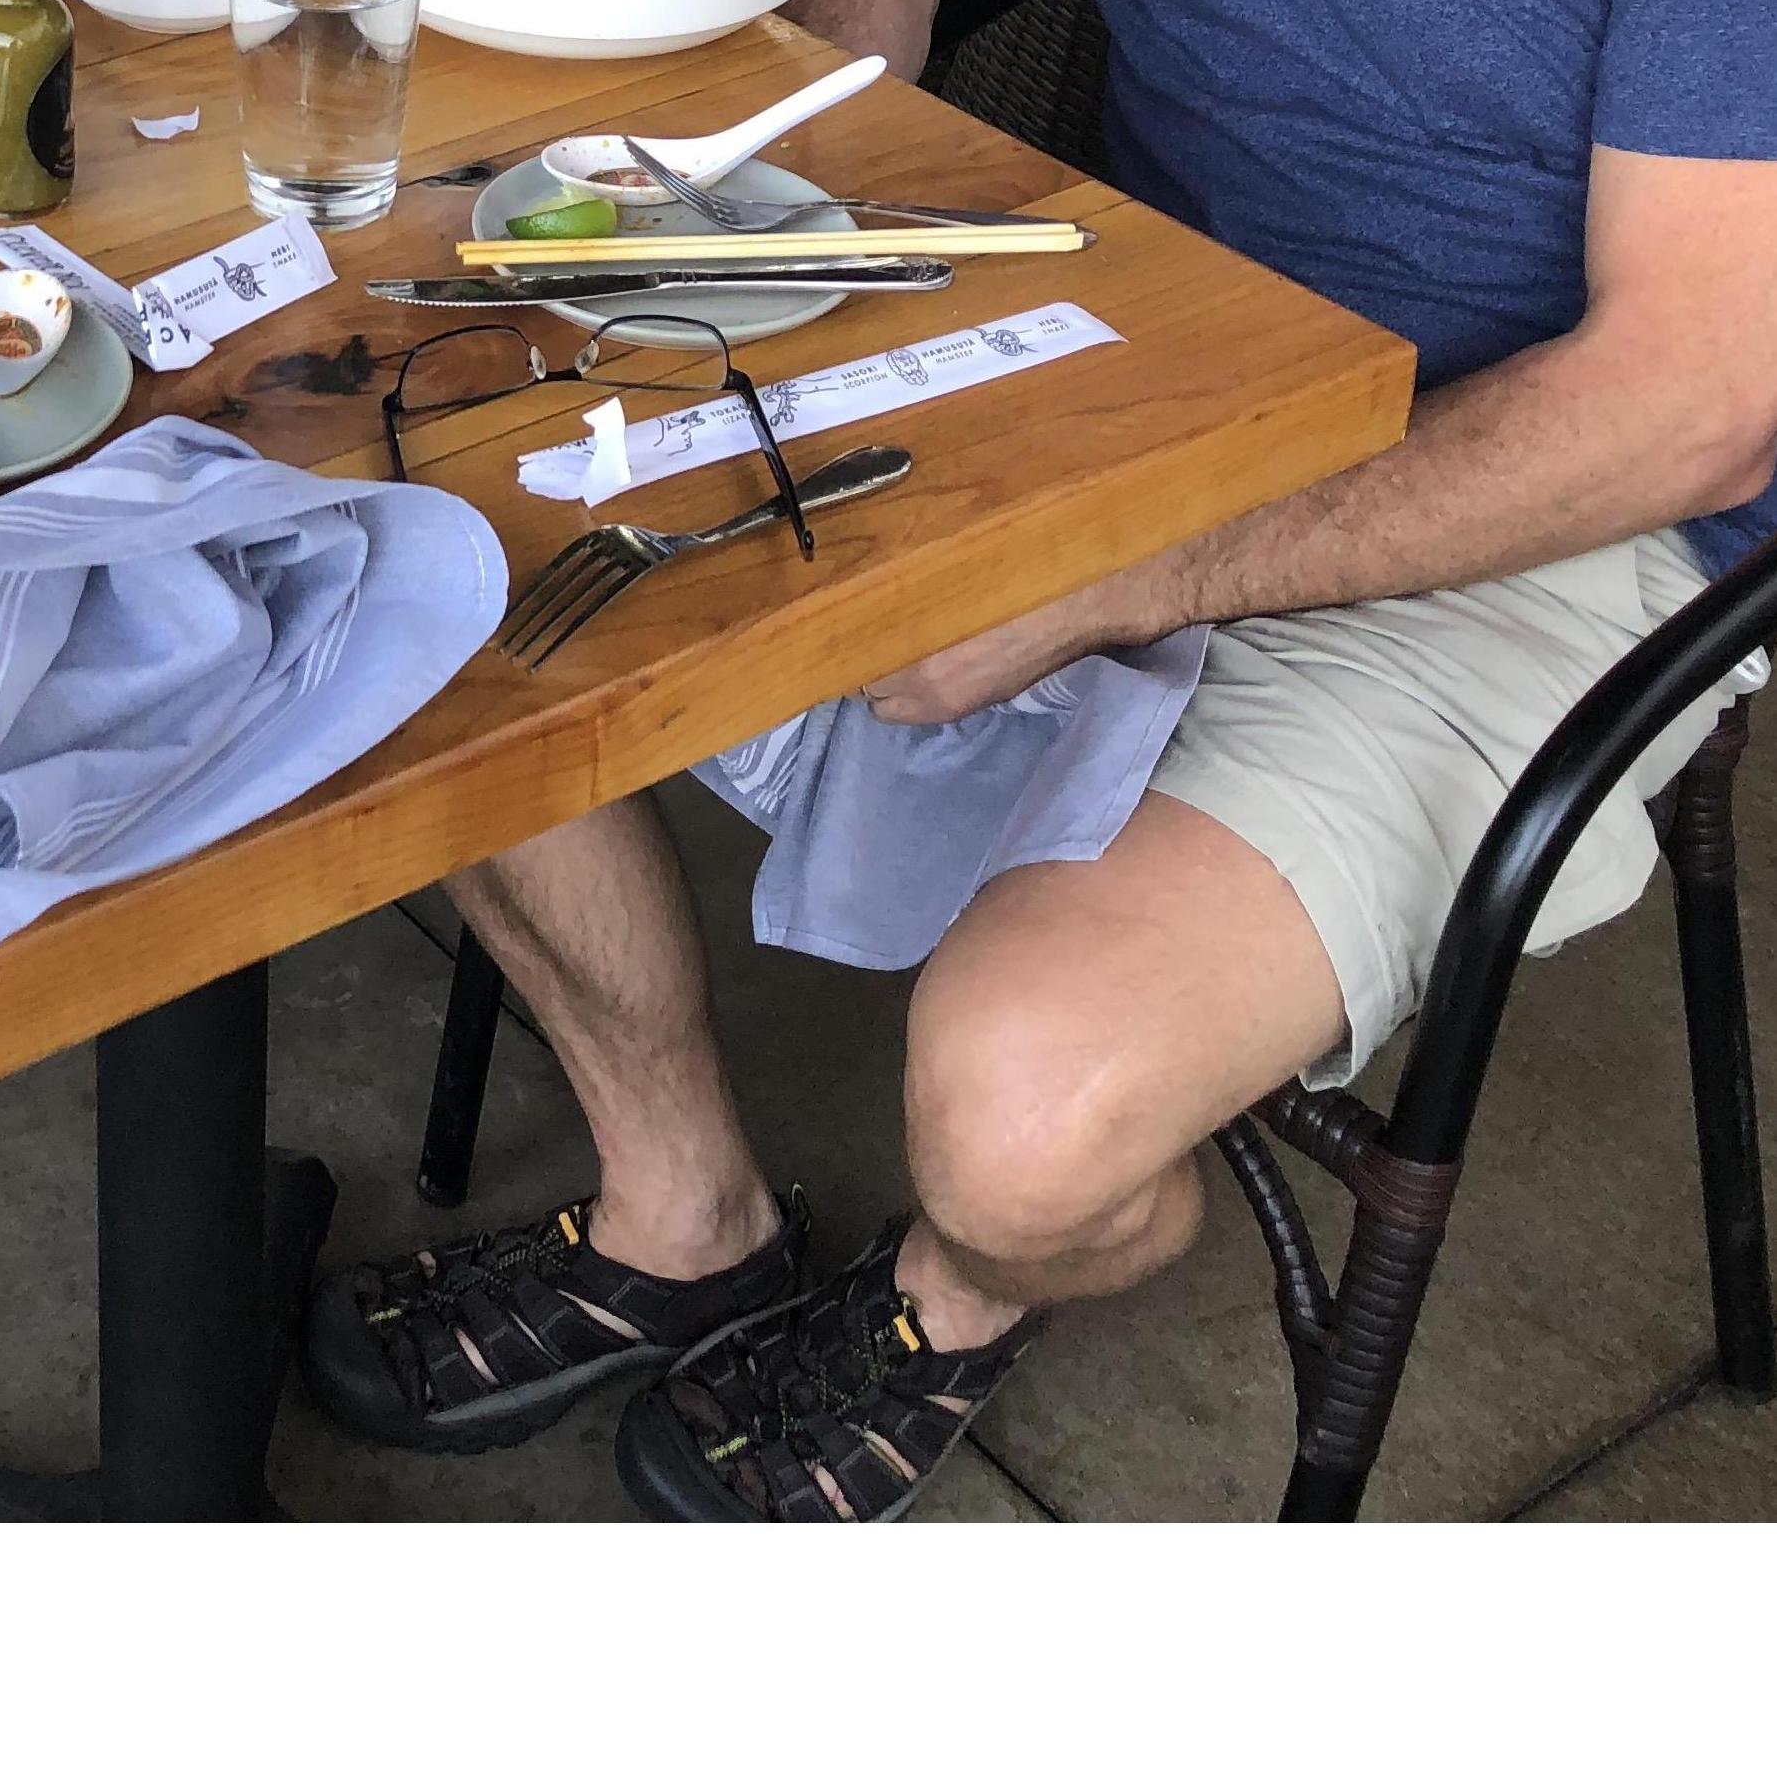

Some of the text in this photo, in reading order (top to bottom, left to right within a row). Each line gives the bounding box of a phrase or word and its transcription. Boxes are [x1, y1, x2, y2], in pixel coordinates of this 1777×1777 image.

[935, 349, 974, 365] HAMSTER
[840, 364, 879, 381] SASORI
[843, 372, 889, 390] SCORPION
